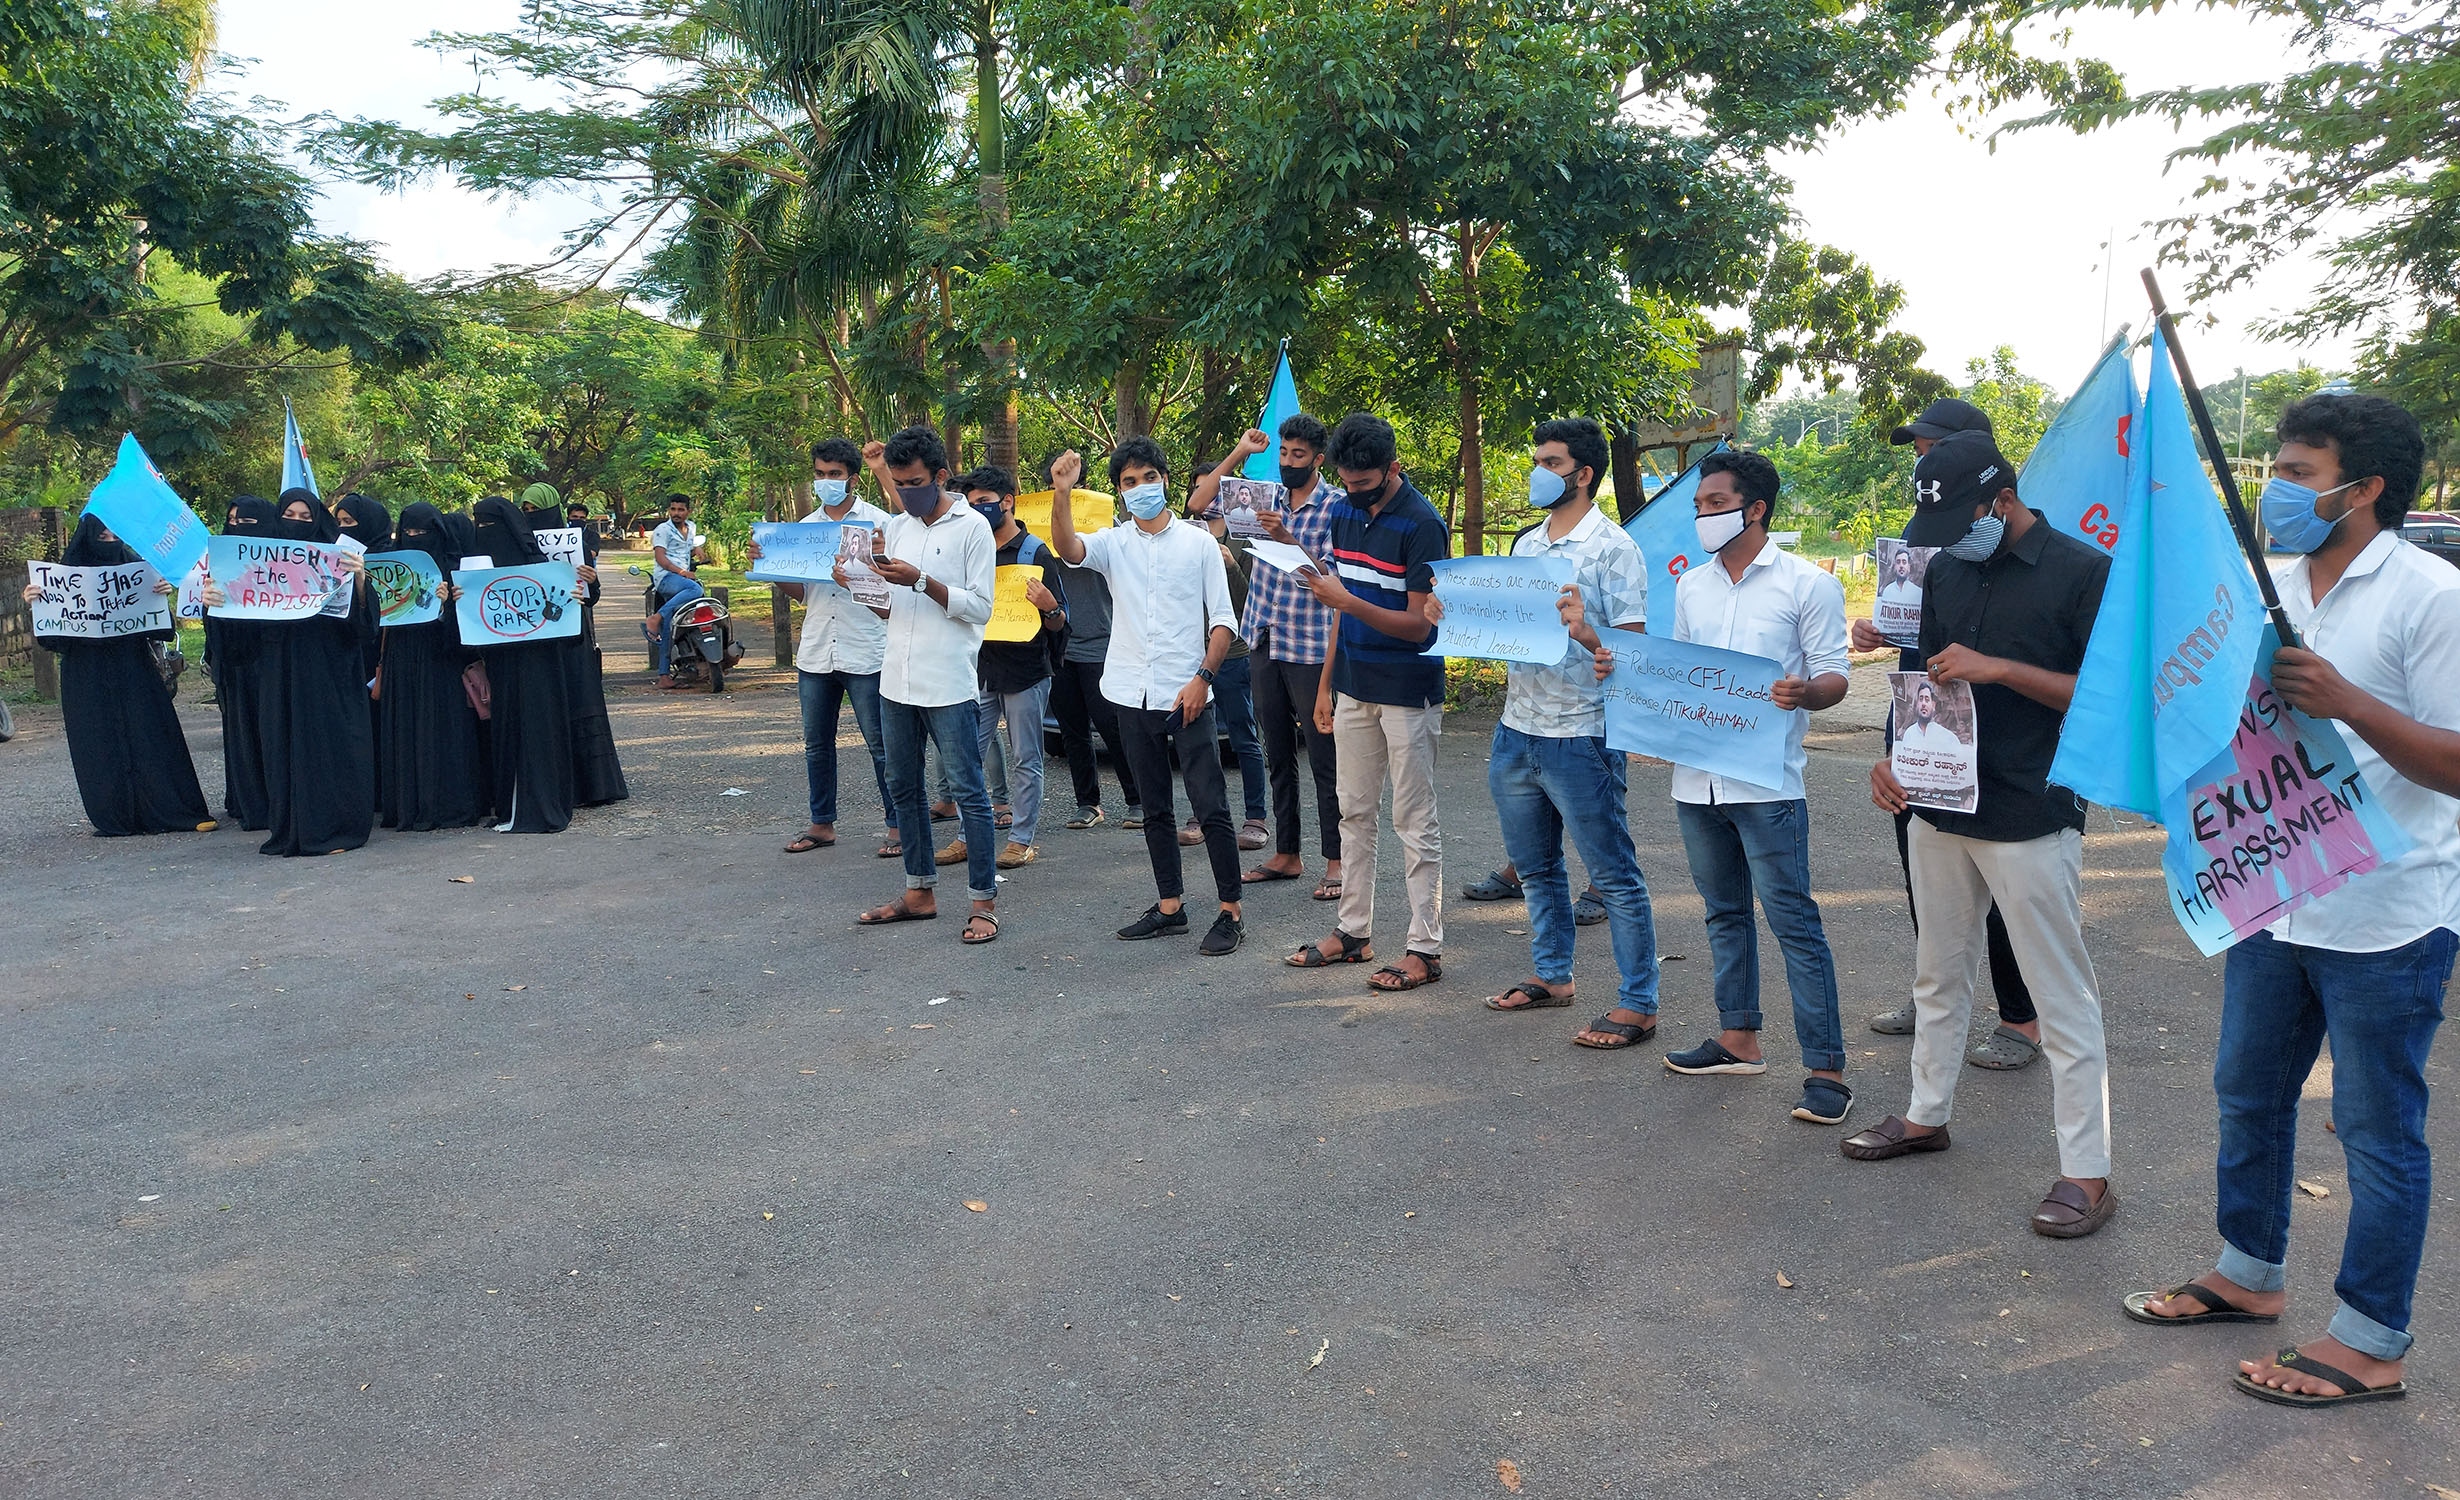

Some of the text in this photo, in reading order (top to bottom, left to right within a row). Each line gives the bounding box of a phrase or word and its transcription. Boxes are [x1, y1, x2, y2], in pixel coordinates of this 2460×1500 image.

[536, 533, 563, 547] RCY
[776, 531, 800, 547] police
[806, 531, 830, 545] should
[238, 543, 321, 566] PUNISH
[36, 567, 144, 596] TIME HAS
[254, 566, 288, 585] the
[365, 564, 407, 586] TOP
[1441, 567, 1467, 586] These
[39, 589, 140, 610] NOW TO TAKE
[487, 586, 537, 611] STOP
[36, 619, 88, 633] CAMPUS
[101, 610, 165, 634] FRONT
[61, 608, 111, 621] ACTION
[493, 609, 537, 628] RAPE
[1515, 604, 1536, 623] the
[1880, 605, 1902, 620] ATIKUR
[1443, 625, 1531, 656] Student Leaders
[1687, 666, 1727, 691] CFI
[2189, 740, 2336, 842] EXUAL
[2177, 771, 2364, 926] HARASSMENT
